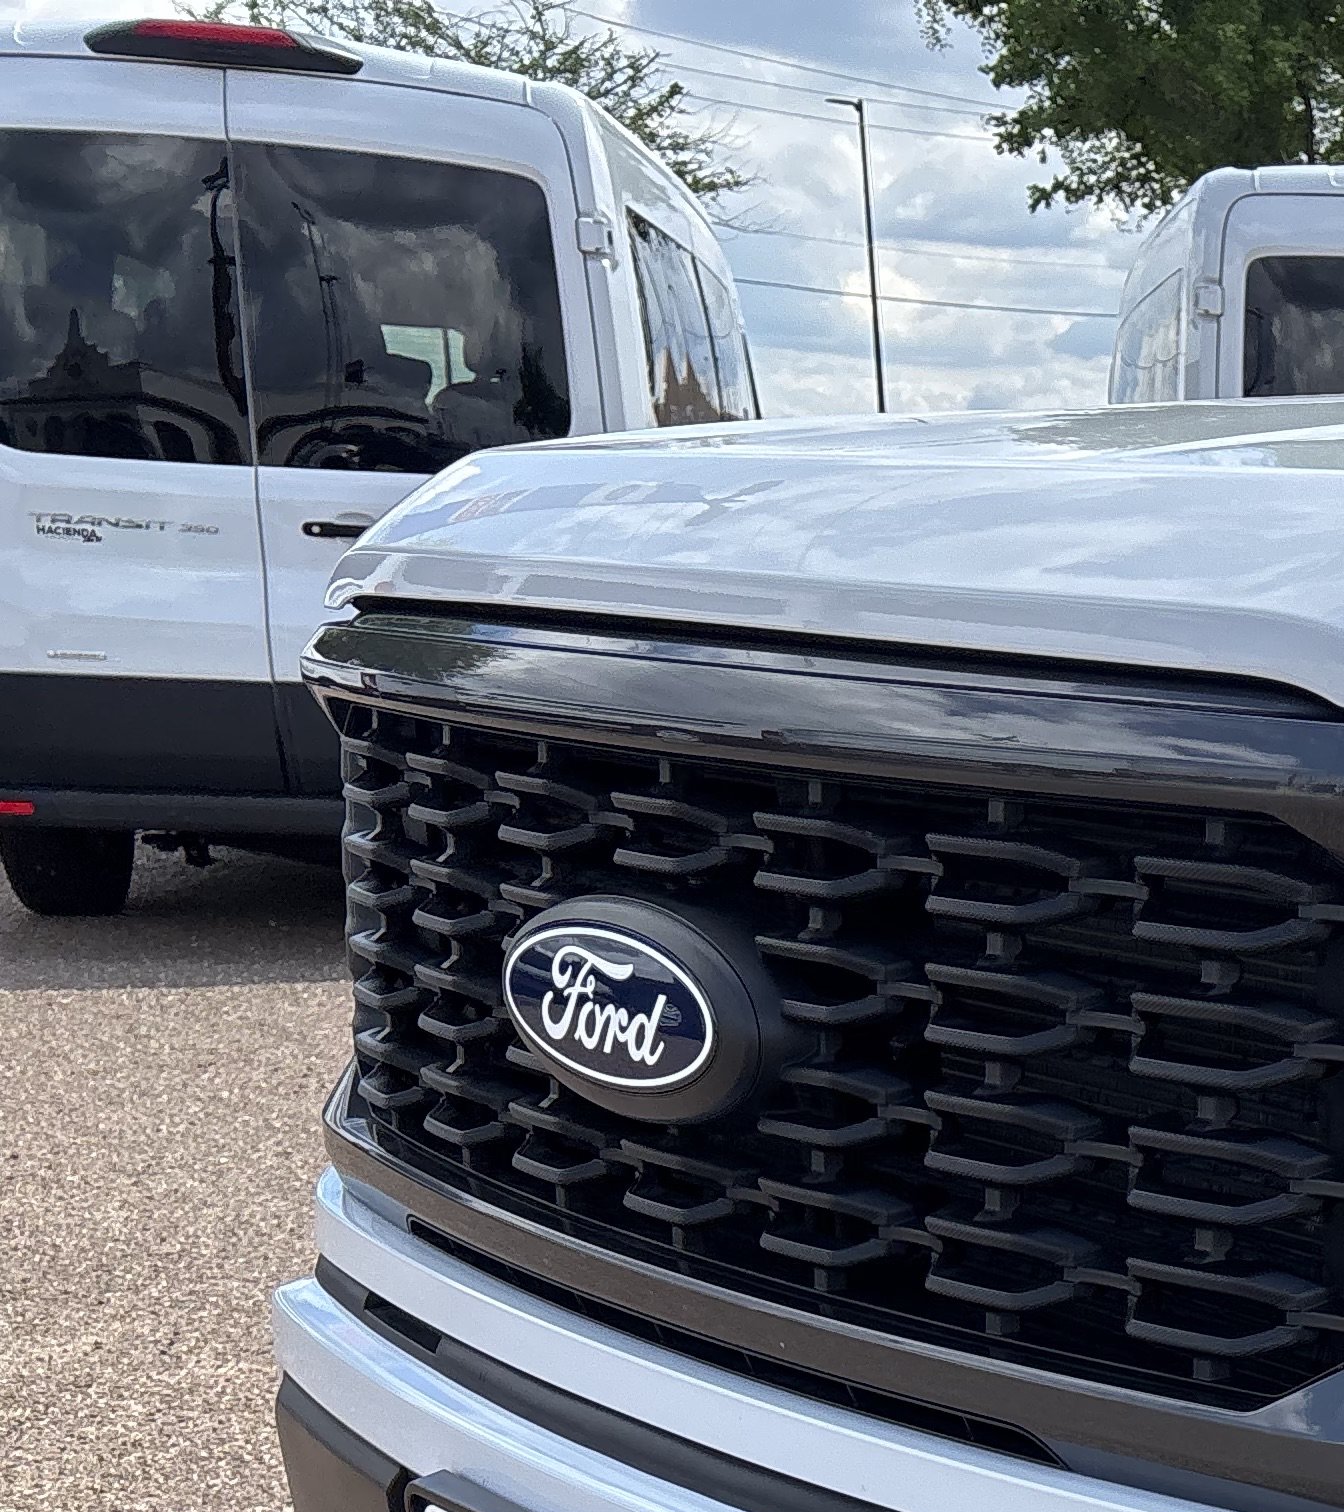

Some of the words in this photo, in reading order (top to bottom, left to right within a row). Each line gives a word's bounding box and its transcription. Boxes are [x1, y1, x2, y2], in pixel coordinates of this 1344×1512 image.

[28, 511, 175, 531] TRANSIT
[36, 525, 97, 539] HACIENDA
[541, 945, 666, 1066] Ford
